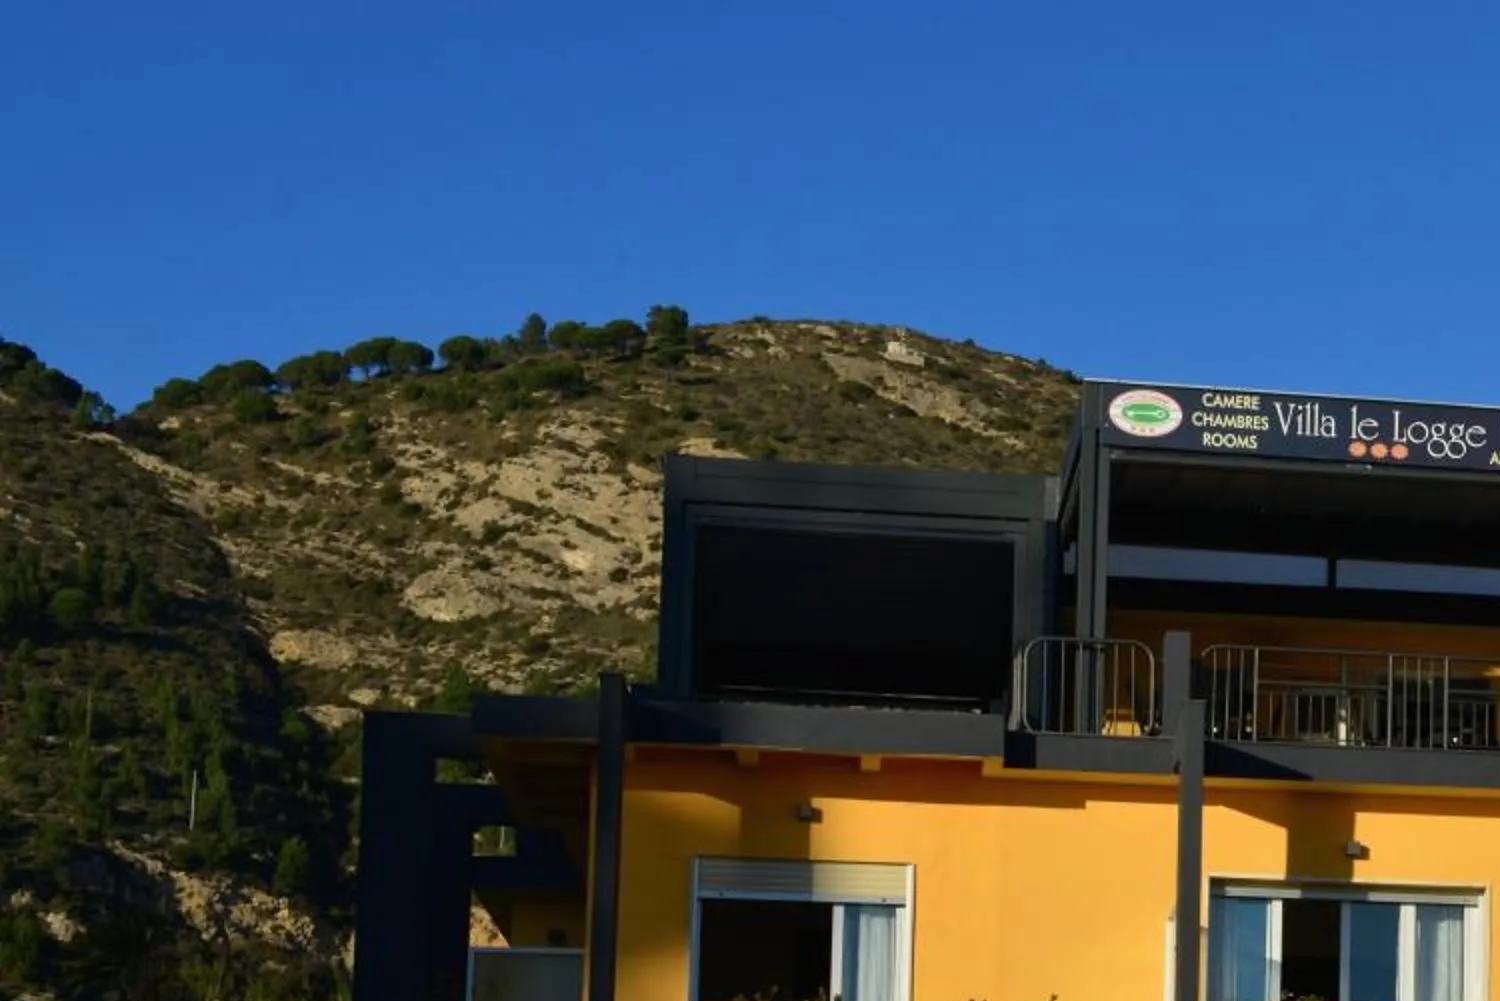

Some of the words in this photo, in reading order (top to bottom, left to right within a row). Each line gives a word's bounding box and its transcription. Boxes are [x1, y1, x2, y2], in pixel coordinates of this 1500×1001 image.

[1201, 392, 1260, 410] CAMERE
[1191, 412, 1269, 431] CHAMBRES
[1273, 401, 1337, 438] Villa
[1350, 404, 1380, 441] le
[1392, 409, 1487, 459] Logge
[1202, 432, 1258, 449] ROOMS
